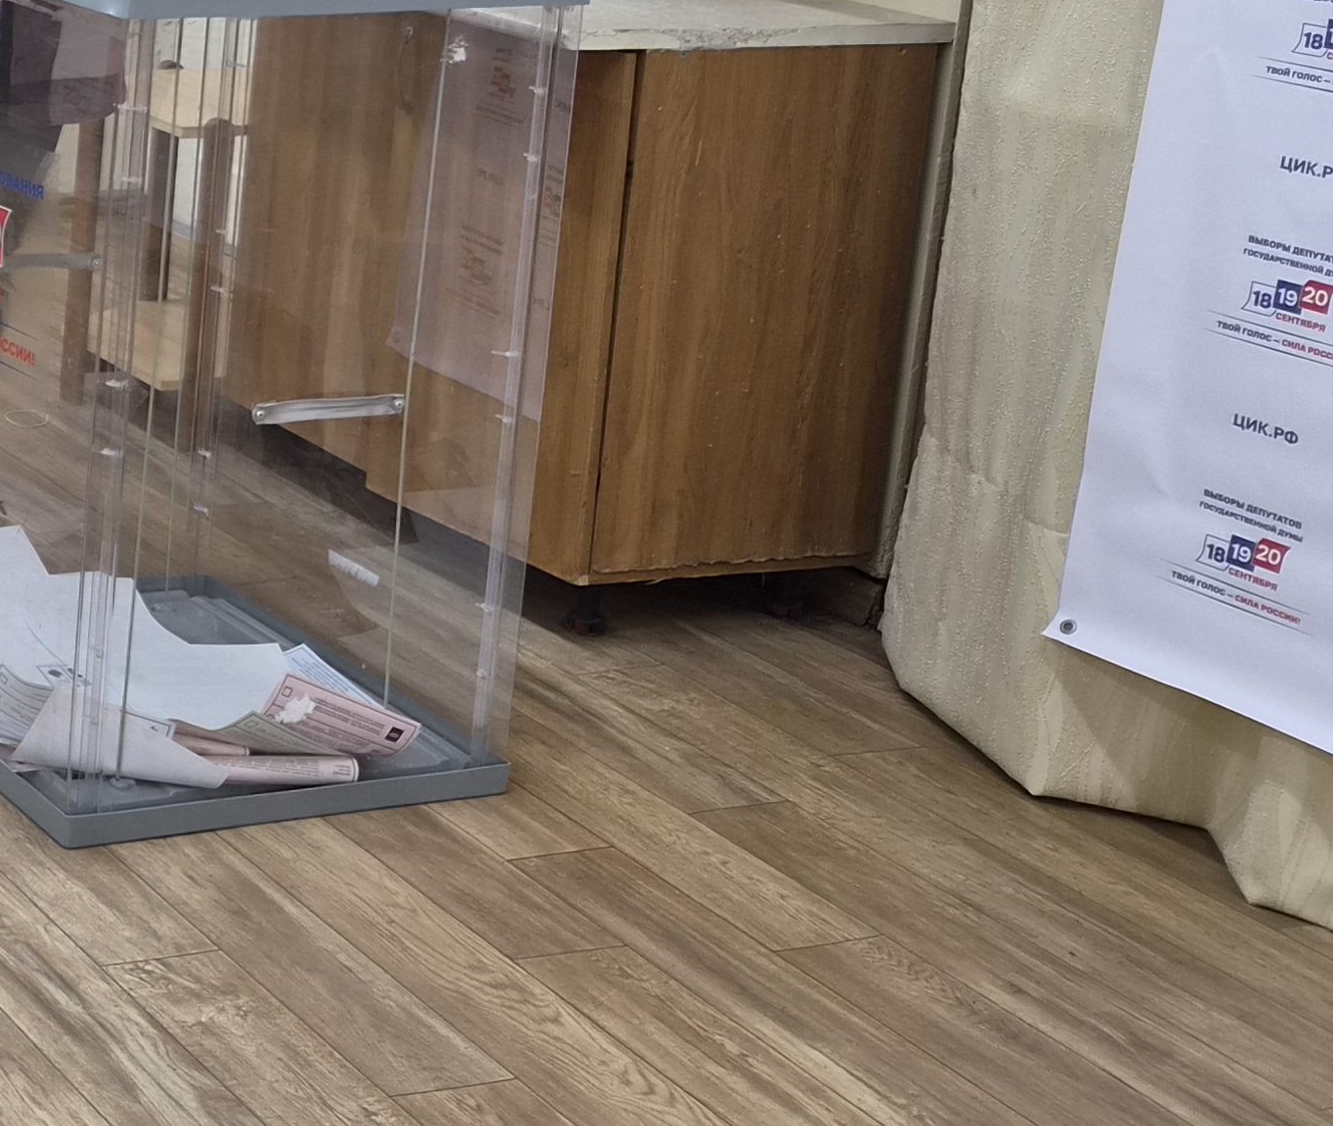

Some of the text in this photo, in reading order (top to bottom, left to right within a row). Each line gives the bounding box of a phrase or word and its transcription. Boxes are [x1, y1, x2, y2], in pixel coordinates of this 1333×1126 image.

[1303, 31, 1324, 50] 18
[1266, 65, 1291, 78] ТВОЙ
[1292, 70, 1323, 83] ГОЛОС
[1247, 234, 1292, 253] ВЫБОРЫ
[1242, 247, 1324, 276] ГОСУДАРСТВЕННОЙ
[1252, 286, 1329, 309] 18 19 20
[1275, 311, 1326, 333] СЕНТЯБРЯ
[1216, 320, 1241, 334] ТВОЙ
[1242, 327, 1273, 343] ГОЛОС
[1281, 339, 1307, 353] СИЛА
[1307, 346, 1333, 361] РОСС
[1232, 413, 1300, 445] ЦИК.РФ
[1203, 488, 1303, 530] ВЫБОРЫ ДЕПУТАТОВ
[1199, 501, 1303, 543] ГОСУДАРСТВЕННОЙ ДУМЫ
[1206, 543, 1282, 566] 18 19 20
[1228, 567, 1278, 592] СЕНТЯБРЯ
[1171, 570, 1196, 586] ТВОЙ
[1196, 578, 1226, 596] ГОЛОС
[1234, 594, 1259, 609] СИЛА
[1260, 603, 1302, 625] РОССИИ!
